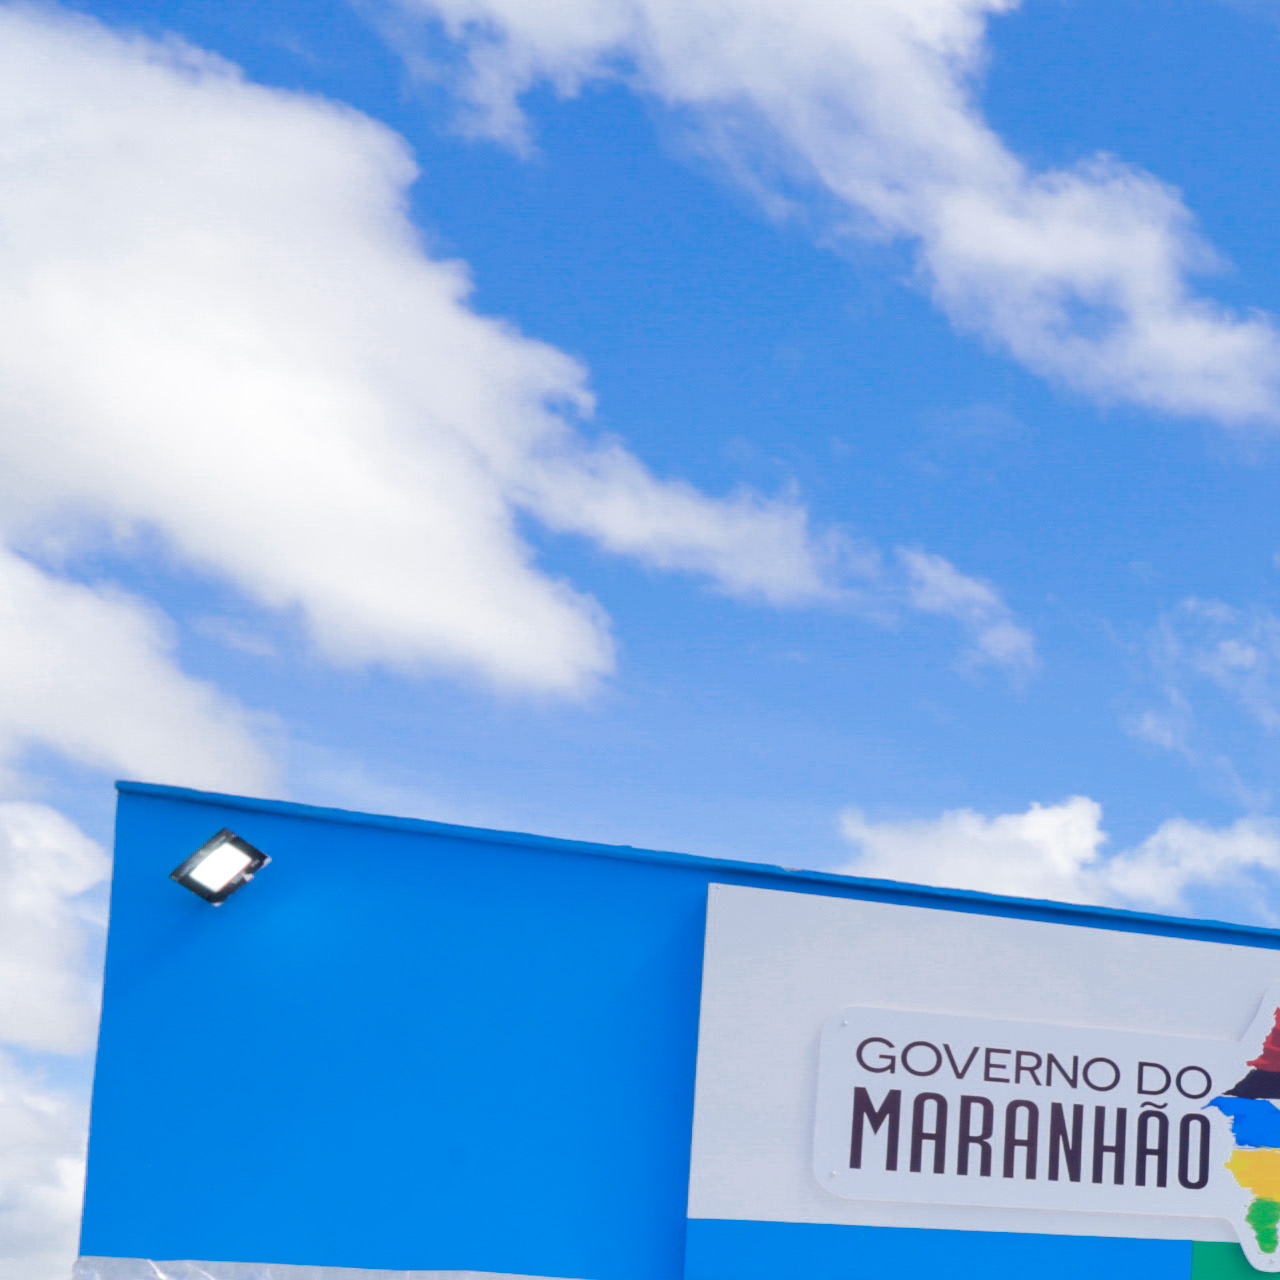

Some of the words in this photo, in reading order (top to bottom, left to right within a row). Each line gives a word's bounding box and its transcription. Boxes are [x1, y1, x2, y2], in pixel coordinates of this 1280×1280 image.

[855, 1036, 1122, 1092] GOVERNO
[1137, 1062, 1213, 1100] DO
[848, 1086, 1212, 1191] MARANHÃO
